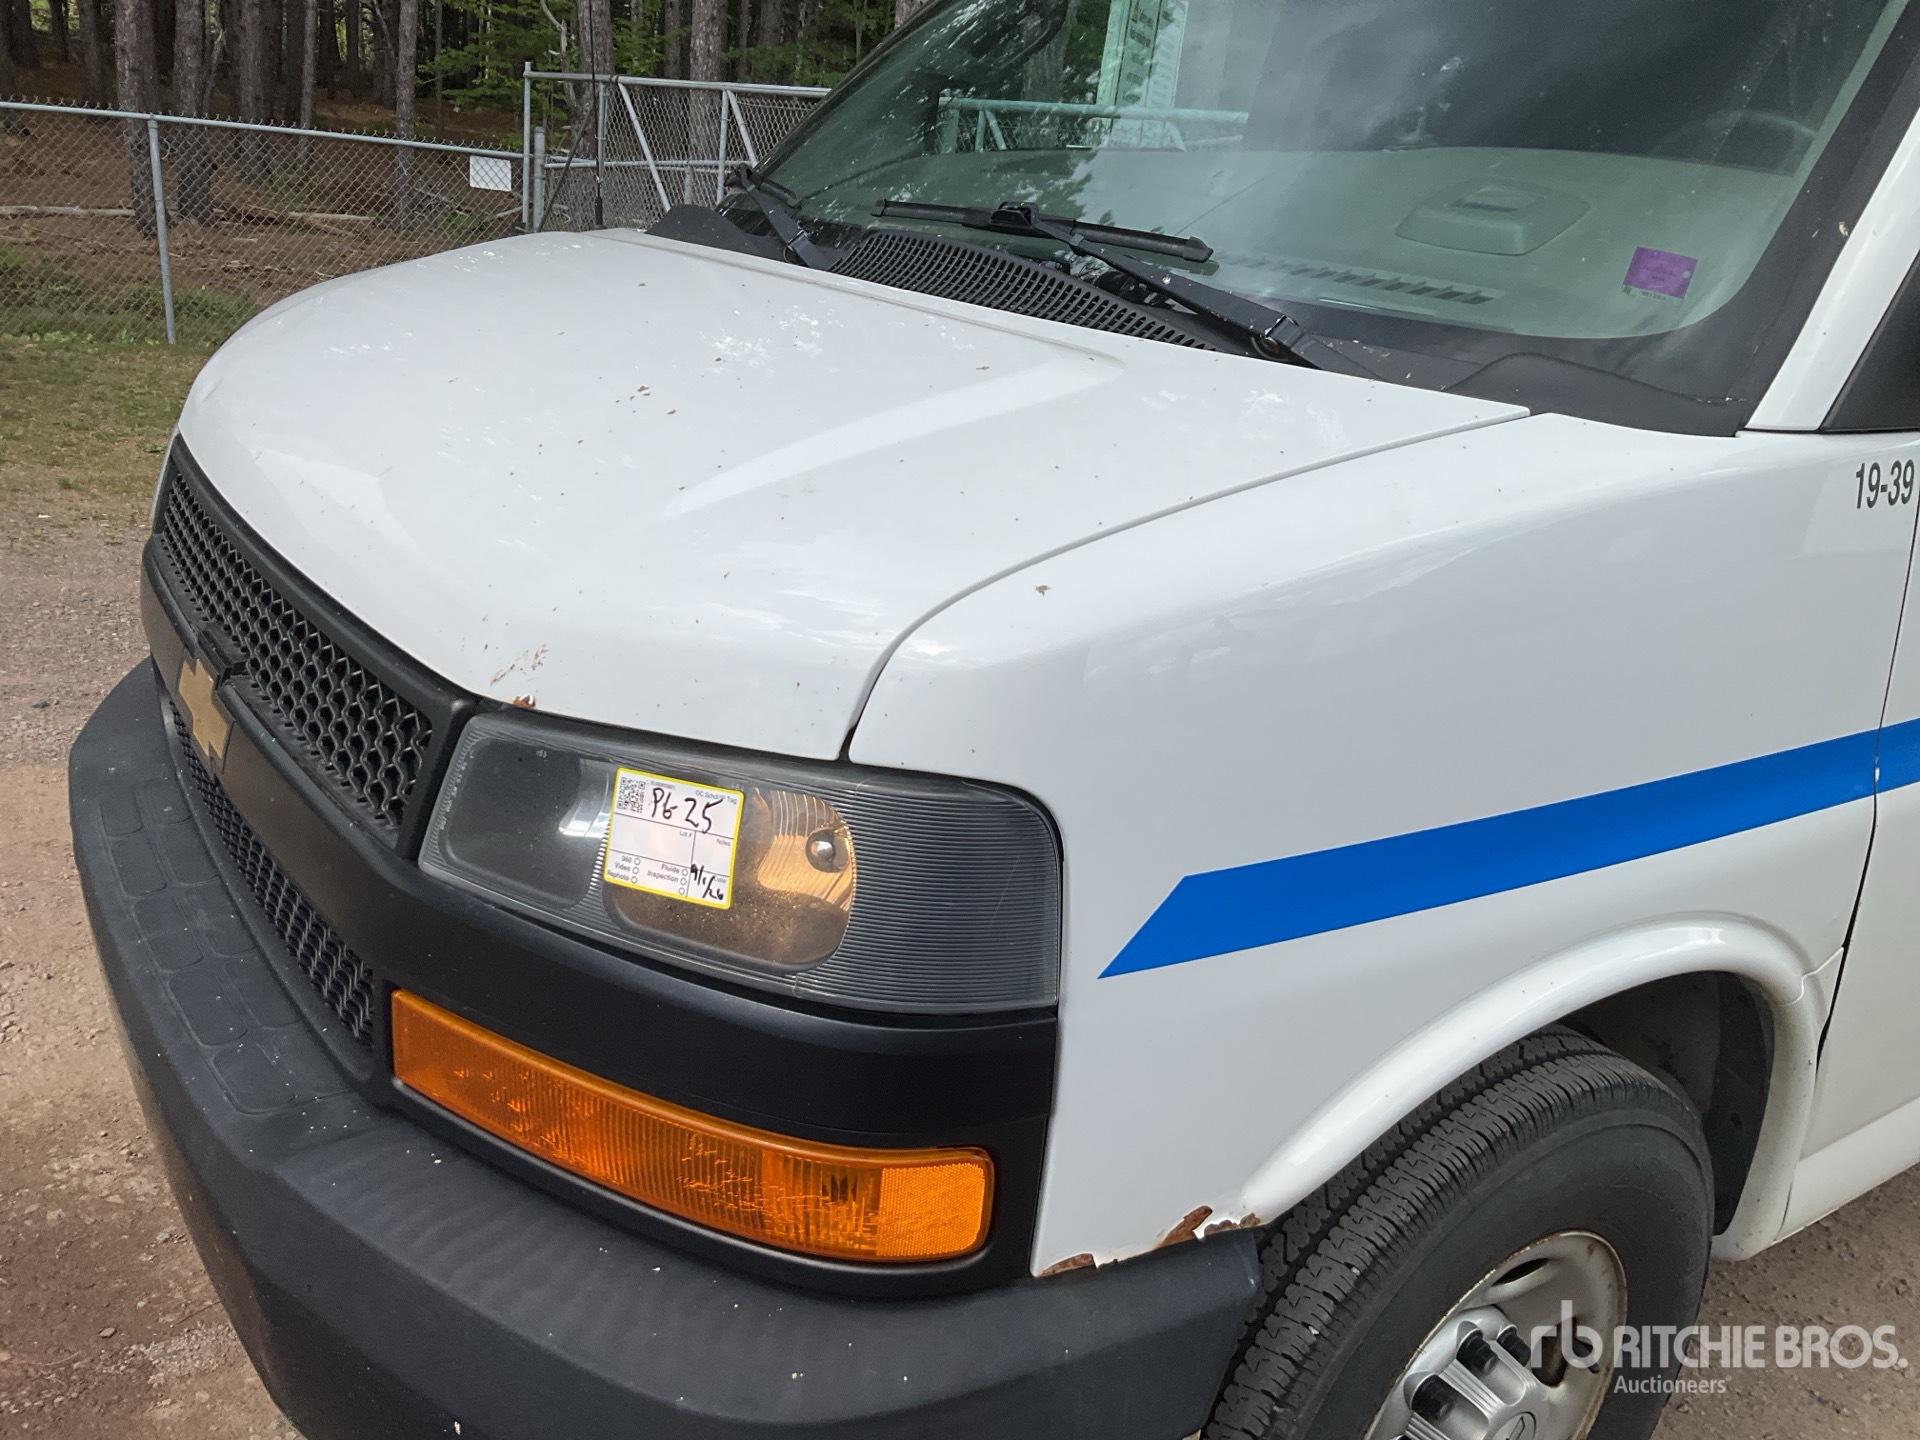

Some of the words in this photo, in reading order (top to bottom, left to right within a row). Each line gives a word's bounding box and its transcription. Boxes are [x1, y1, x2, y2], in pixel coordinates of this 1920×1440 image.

[1856, 459, 1915, 509] 19-39
[716, 838, 731, 847] Notes
[614, 861, 631, 872] Video
[661, 863, 680, 874] Fluids
[647, 869, 679, 883] Inspection
